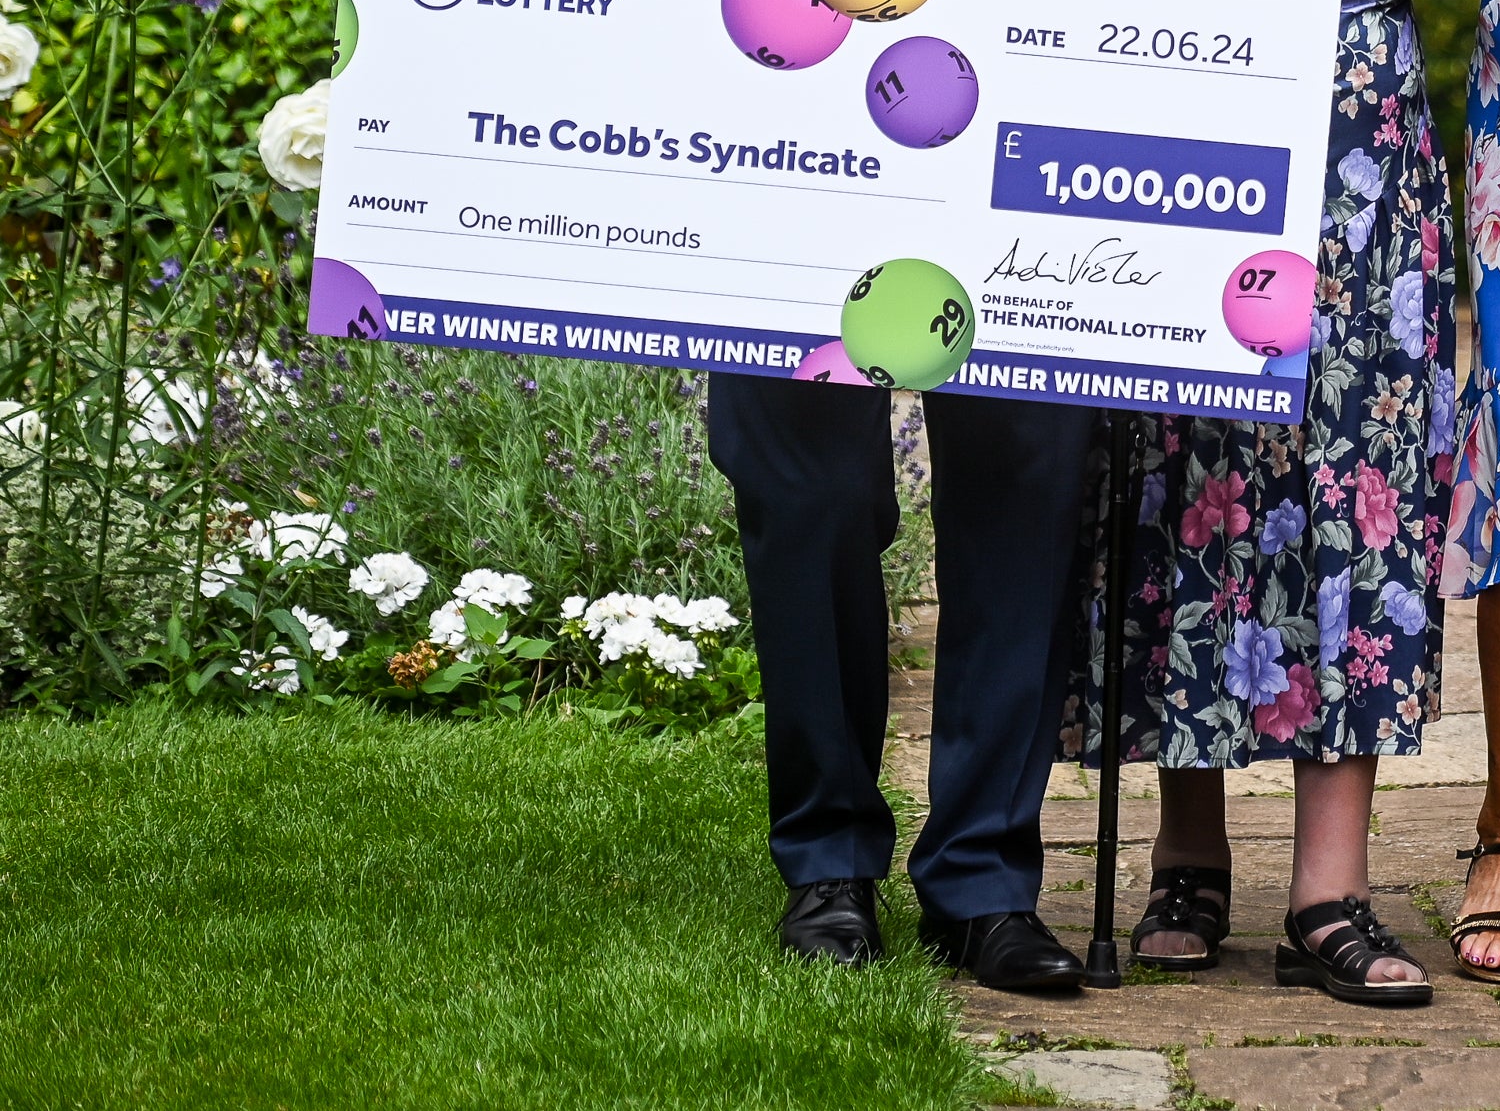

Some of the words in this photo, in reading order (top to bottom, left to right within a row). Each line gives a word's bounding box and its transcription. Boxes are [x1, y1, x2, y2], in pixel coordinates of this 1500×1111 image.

[1005, 25, 1066, 49] DATE
[1097, 23, 1255, 67] 22.06.24
[874, 70, 905, 104] 11
[357, 118, 391, 135] PAY
[467, 111, 541, 148] The
[686, 131, 882, 179] Syndicate
[1039, 160, 1267, 216] 1,000,000
[348, 194, 429, 215] AMOUNT
[458, 205, 513, 232] One
[518, 213, 600, 241] million
[605, 225, 702, 250] pounds
[981, 293, 1001, 305] ON
[1003, 296, 1054, 309] BEHALF
[1056, 301, 1074, 311] OF
[1239, 269, 1277, 291] 07
[930, 298, 966, 348] 29
[981, 309, 1018, 326] THE
[1021, 313, 1118, 336] NATIONAL
[1121, 322, 1207, 343] LOTTERY
[442, 313, 558, 347] WINNER
[564, 325, 680, 358] WINNER
[686, 335, 803, 369] WINNER
[1053, 369, 1169, 403] WINNER
[1176, 380, 1292, 414] WINNER
